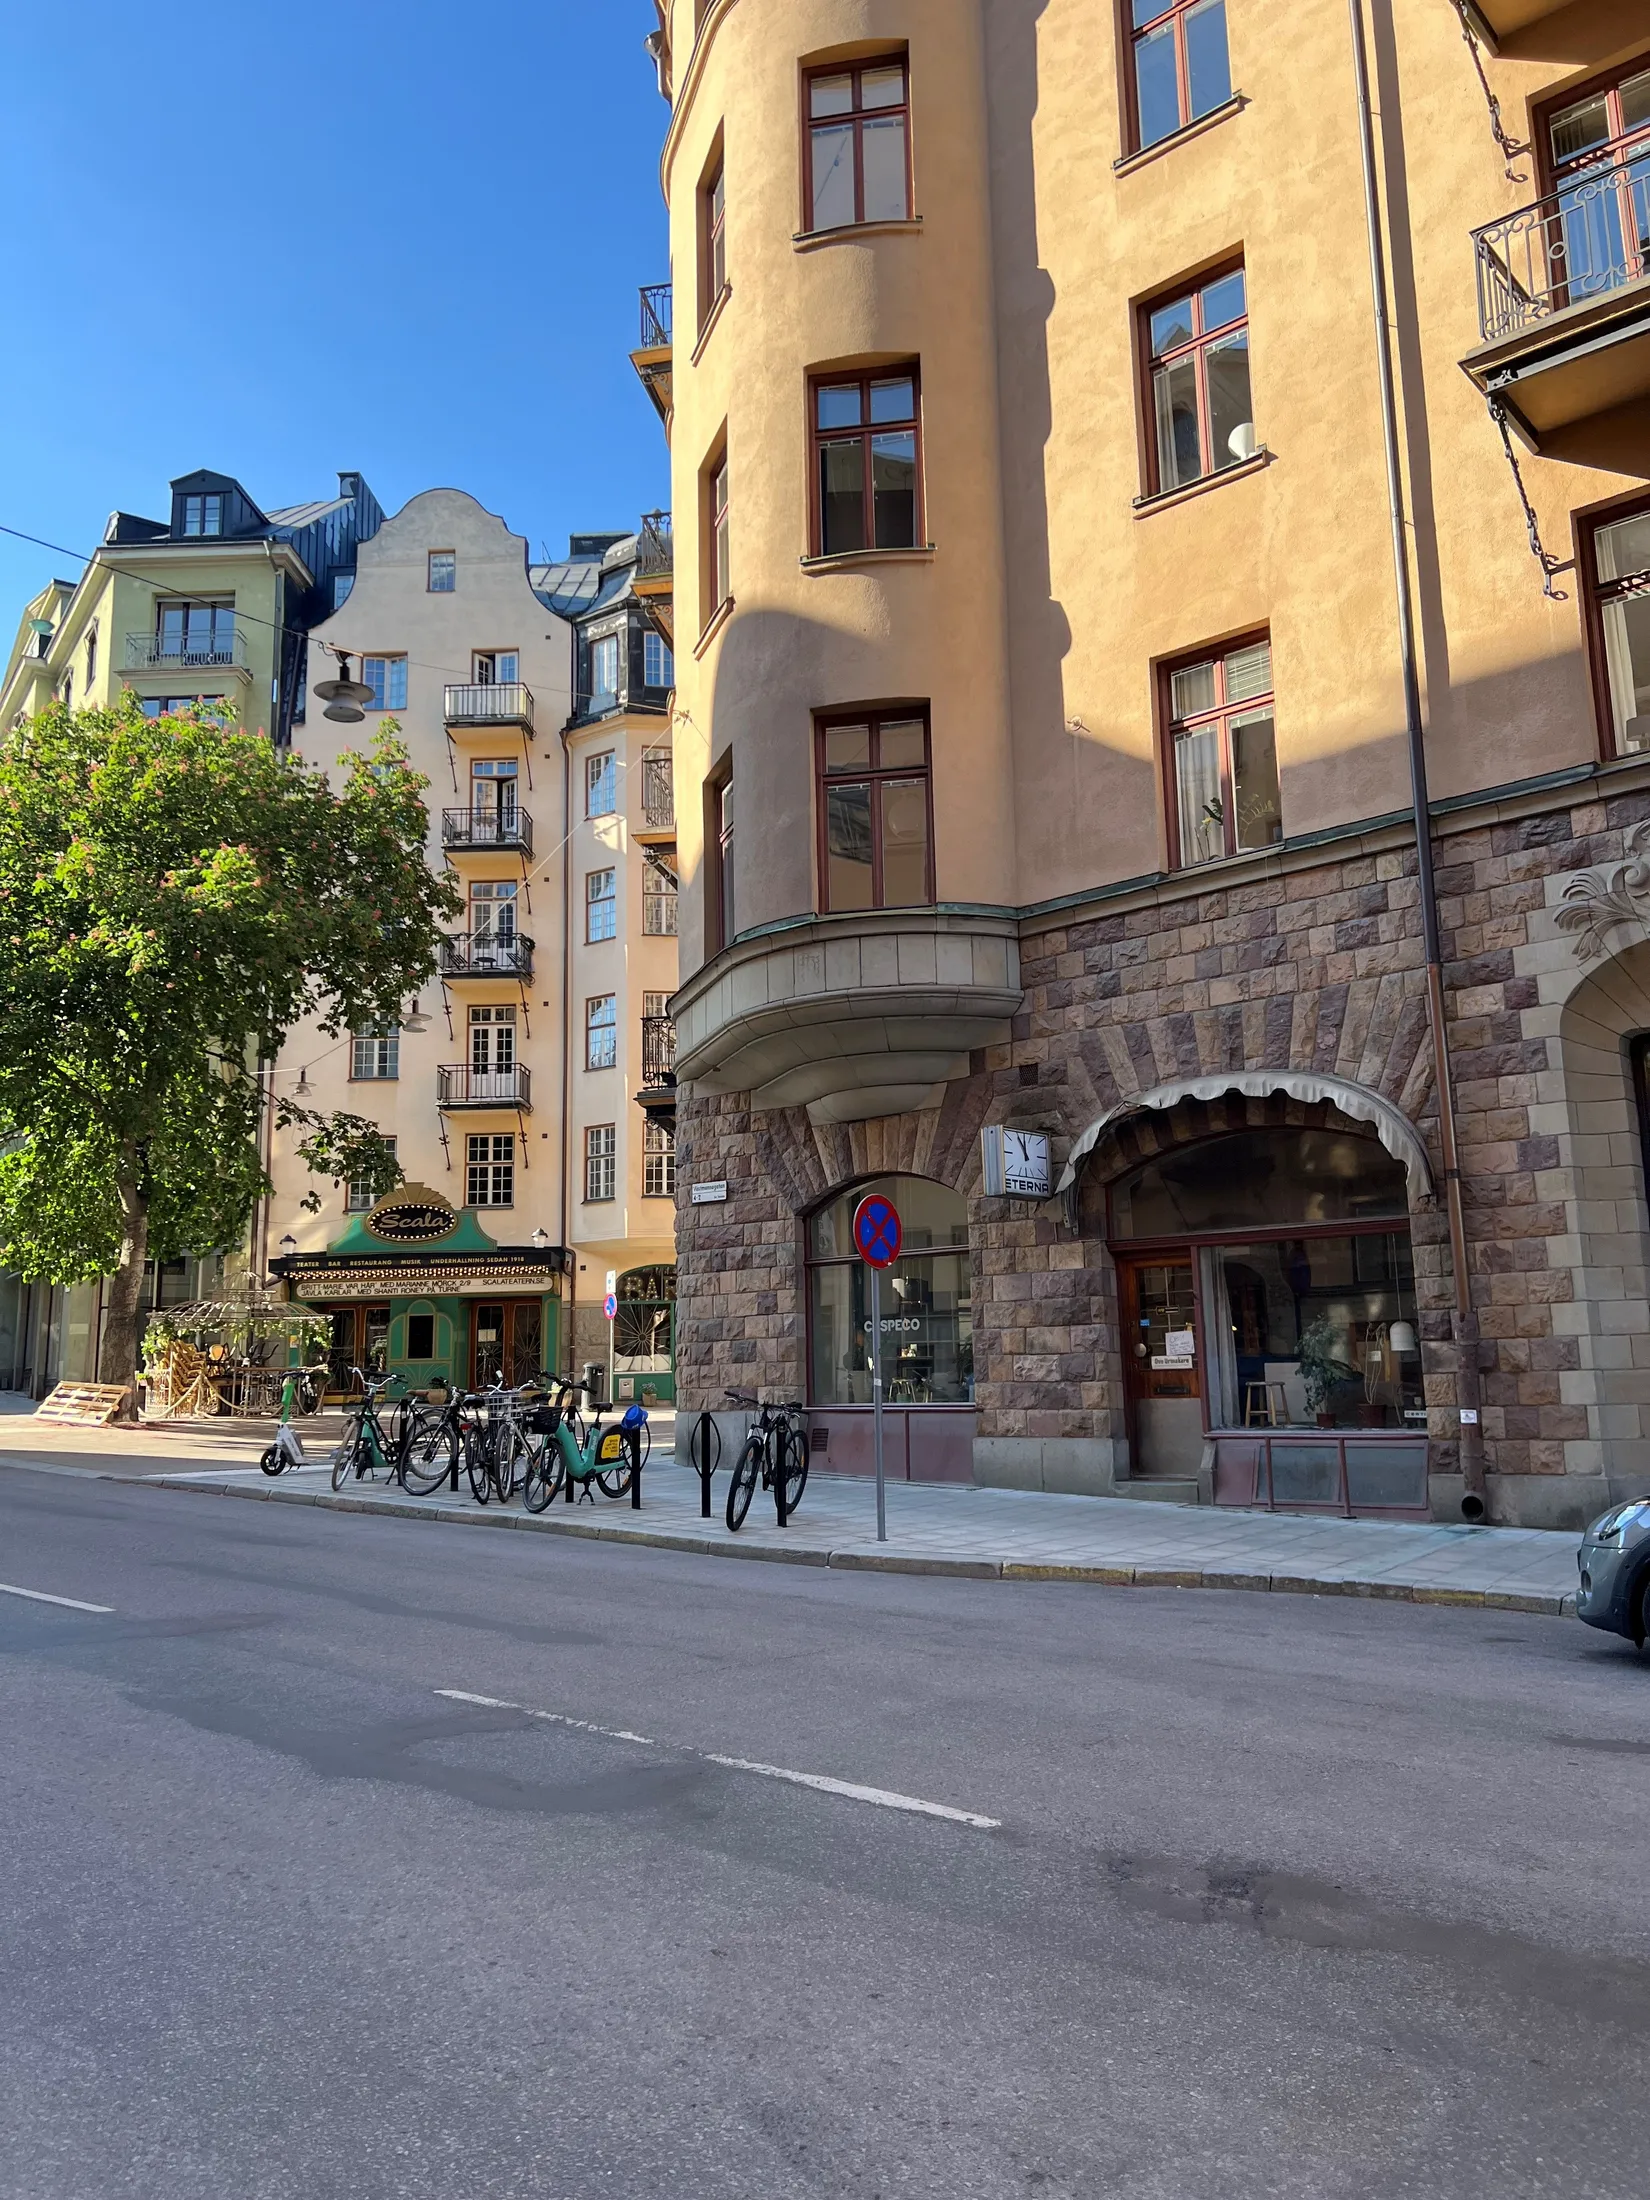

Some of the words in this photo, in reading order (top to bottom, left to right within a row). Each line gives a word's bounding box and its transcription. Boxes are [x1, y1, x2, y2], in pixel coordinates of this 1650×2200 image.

[1005, 1178, 1049, 1194] ETERNA
[378, 1212, 449, 1229] Scala
[301, 1283, 344, 1291] BRITT-MARIE
[395, 1280, 430, 1288] MARIANNE
[482, 1278, 545, 1286] SCALATEATERN.SE
[324, 1288, 352, 1296] KARLAR
[374, 1287, 399, 1295] SHANTI
[400, 1286, 425, 1294] RONEY
[863, 1317, 921, 1333] CSPECO
